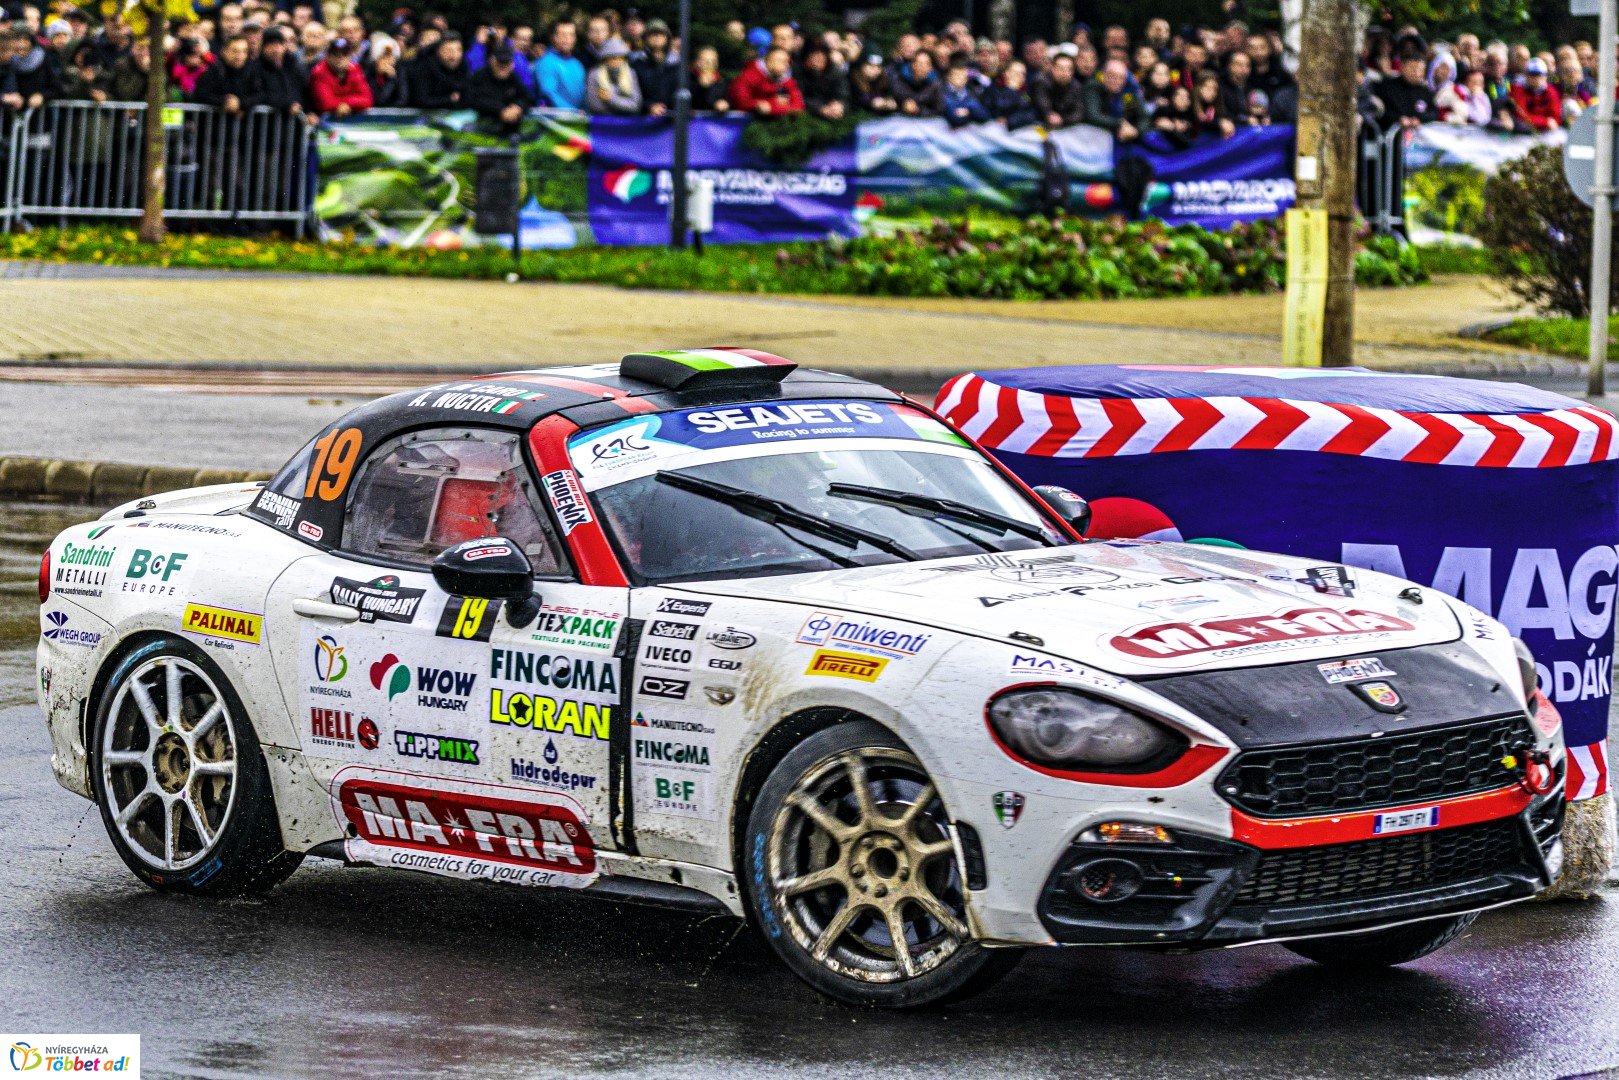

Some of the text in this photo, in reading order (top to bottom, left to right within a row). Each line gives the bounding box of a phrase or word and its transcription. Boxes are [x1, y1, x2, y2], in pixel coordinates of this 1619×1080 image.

[431, 392, 503, 413] NUCITA
[686, 402, 884, 434] SEAJETS
[752, 425, 856, 439] Racing to summer
[304, 427, 363, 501] 19
[546, 471, 588, 529] PHOENIX
[60, 542, 117, 568] Sandrini
[55, 567, 108, 586] METALLI
[121, 581, 176, 597] EUROPE
[1341, 542, 1619, 641] MAG
[361, 595, 421, 616] HUNGARY
[451, 596, 490, 639] 19
[59, 629, 101, 644] WEGH GROUP
[189, 610, 257, 637] PALINAL
[536, 613, 616, 640] TEXPACK
[832, 620, 933, 653] miwenti
[204, 637, 216, 648] Car
[645, 645, 692, 664] IVECO
[490, 649, 618, 695] FINCOMA
[811, 654, 881, 677] PIRELLI
[310, 685, 353, 699] NYÍREGYHÁZA
[417, 666, 478, 698] WOW
[417, 695, 469, 712] HUNGARY
[490, 688, 612, 741] LORAN
[310, 706, 356, 742] HELL
[650, 718, 704, 733] MANUTECNO
[312, 738, 356, 750] ENERGY DRINK
[634, 739, 711, 766] FINCOMA
[510, 757, 596, 791] hidrodepur
[656, 800, 699, 812] EUROPE
[390, 850, 556, 885] cosmetics for your car
